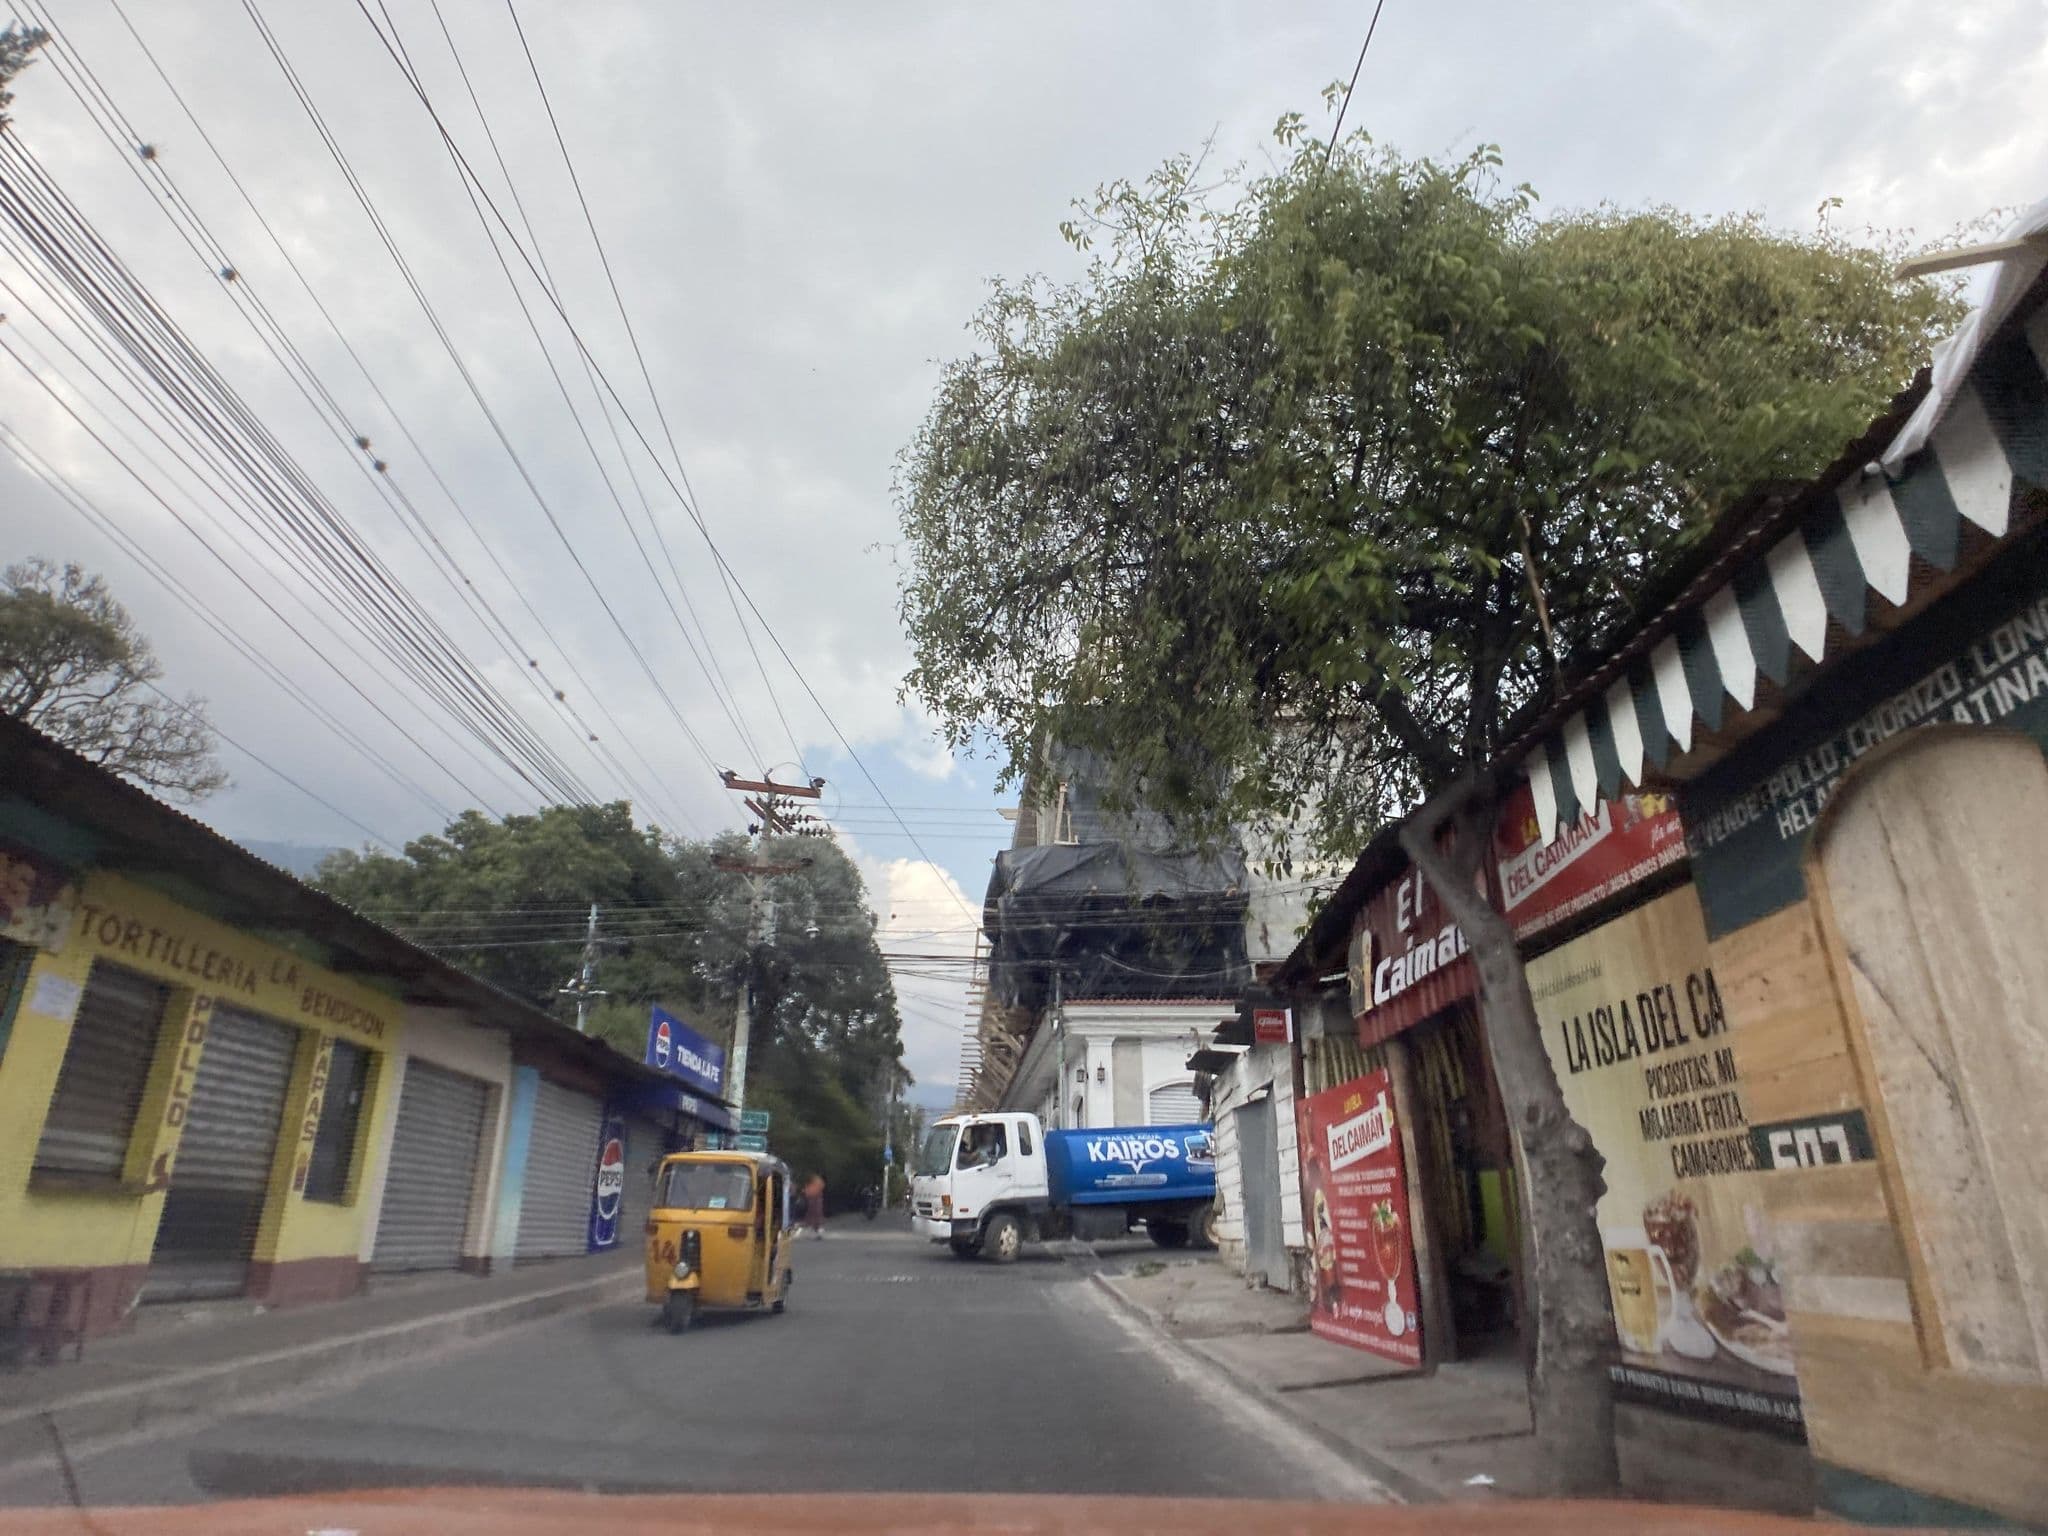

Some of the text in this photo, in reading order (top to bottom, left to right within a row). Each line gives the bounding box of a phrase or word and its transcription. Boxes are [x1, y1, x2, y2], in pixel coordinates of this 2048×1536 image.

[1776, 776, 1841, 840] HELA
[1398, 869, 1423, 933] El
[1508, 864, 1535, 898] DEL
[80, 904, 257, 994] TORTILLERIA
[270, 957, 298, 992] LA
[1562, 1020, 1592, 1075] LA
[1587, 1000, 1641, 1067] ISLA
[1636, 983, 1690, 1054] DEL
[167, 995, 212, 1128] POLLO
[302, 1035, 334, 1141] PAPAS
[1087, 1139, 1180, 1163] KAIROS
[1332, 1136, 1348, 1160] DEL
